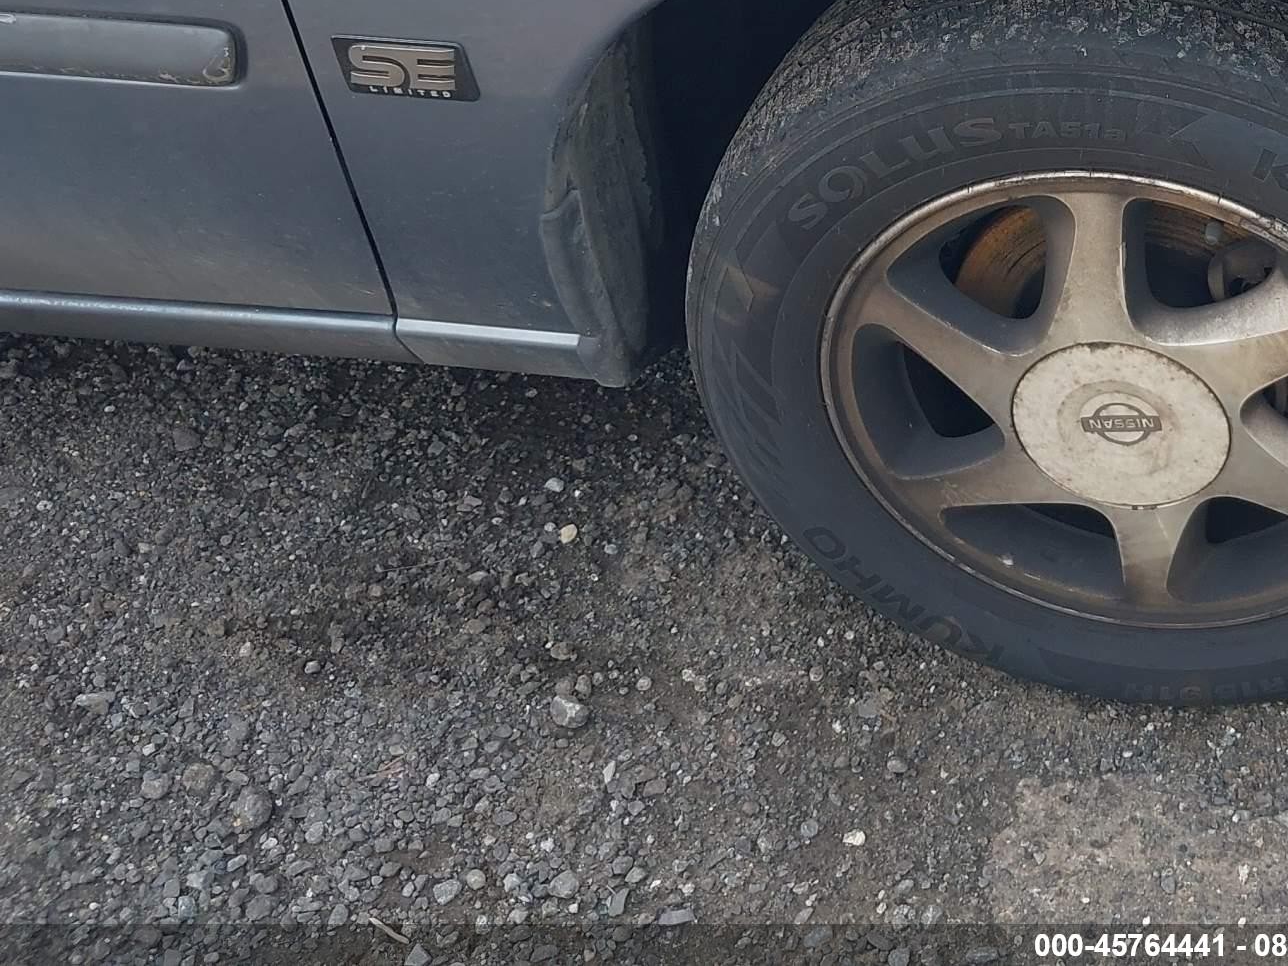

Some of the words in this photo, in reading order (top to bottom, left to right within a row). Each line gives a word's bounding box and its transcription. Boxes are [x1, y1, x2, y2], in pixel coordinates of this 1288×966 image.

[348, 45, 456, 91] SE
[369, 86, 452, 98] LIMITED
[788, 118, 1001, 230] SOLUS
[1088, 418, 1155, 429] NISSAN
[802, 527, 1004, 664] KUMHO
